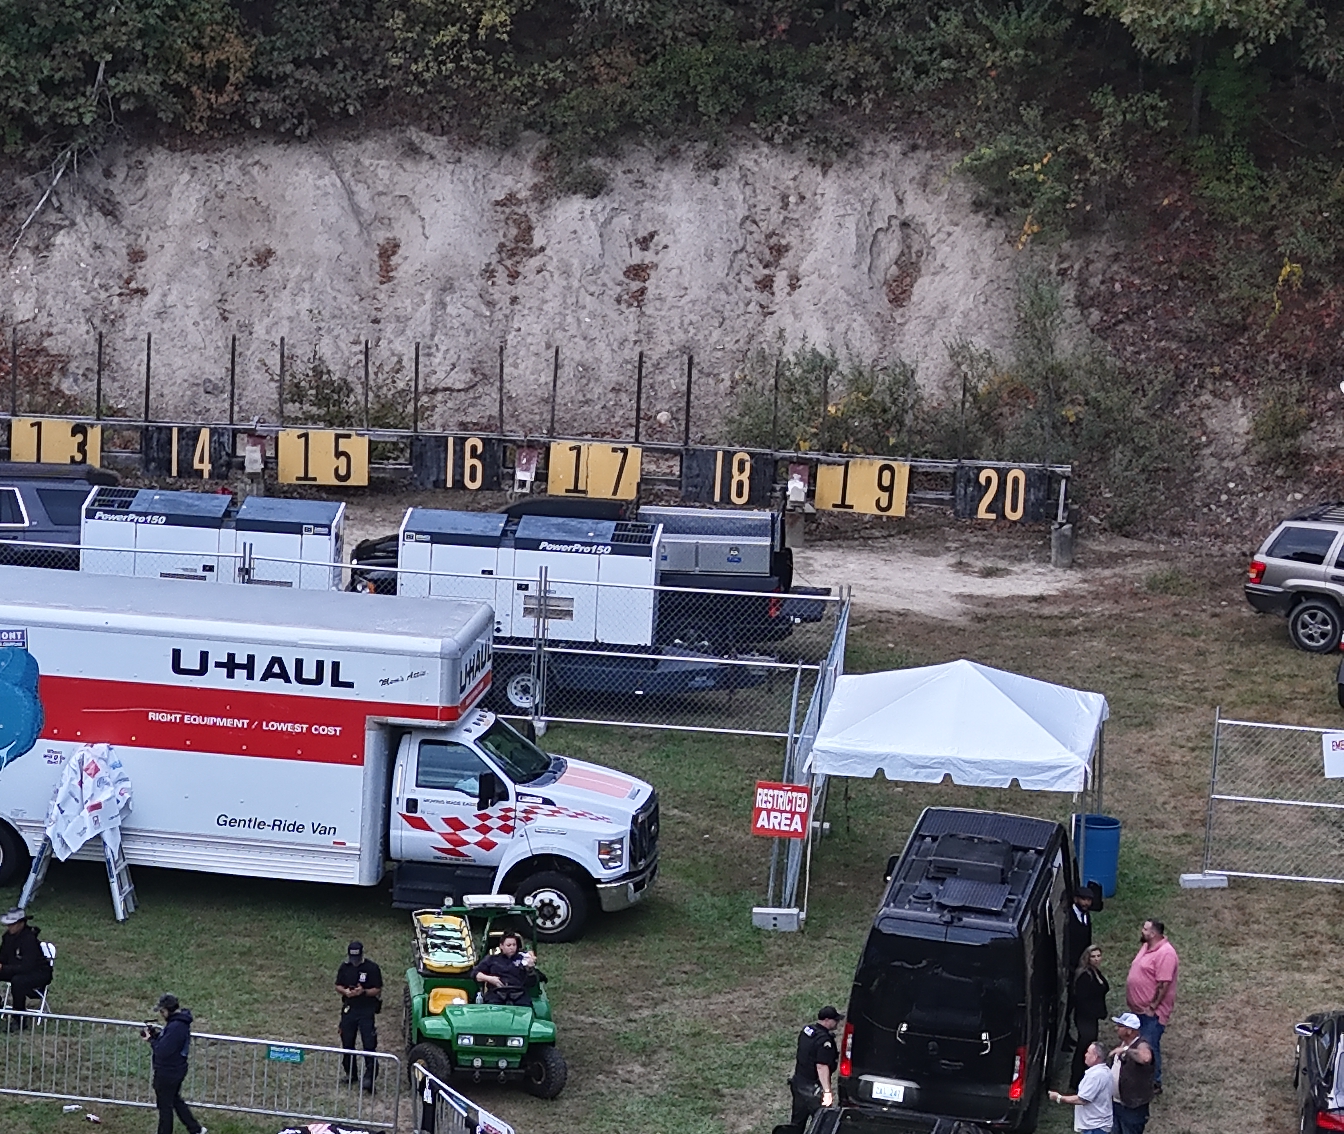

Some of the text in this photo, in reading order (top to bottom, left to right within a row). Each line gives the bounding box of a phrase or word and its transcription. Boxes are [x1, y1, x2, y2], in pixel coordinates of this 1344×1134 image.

[30, 420, 88, 465] 13
[171, 427, 211, 478] 14
[295, 433, 352, 483] 15
[446, 436, 483, 490] 16
[565, 445, 629, 496] 17
[714, 450, 751, 505] 18
[831, 460, 896, 513] 19
[977, 468, 1025, 520] 20
[171, 648, 355, 689] U-HAUL
[148, 712, 182, 724] RIGHT
[184, 714, 250, 729] EQUIPMENT
[262, 721, 309, 734] LOWEST
[312, 725, 342, 737] COST
[216, 813, 337, 837] Gentle-Ride Van
[756, 788, 808, 812] RESTRICTED
[756, 810, 803, 832] AREA
